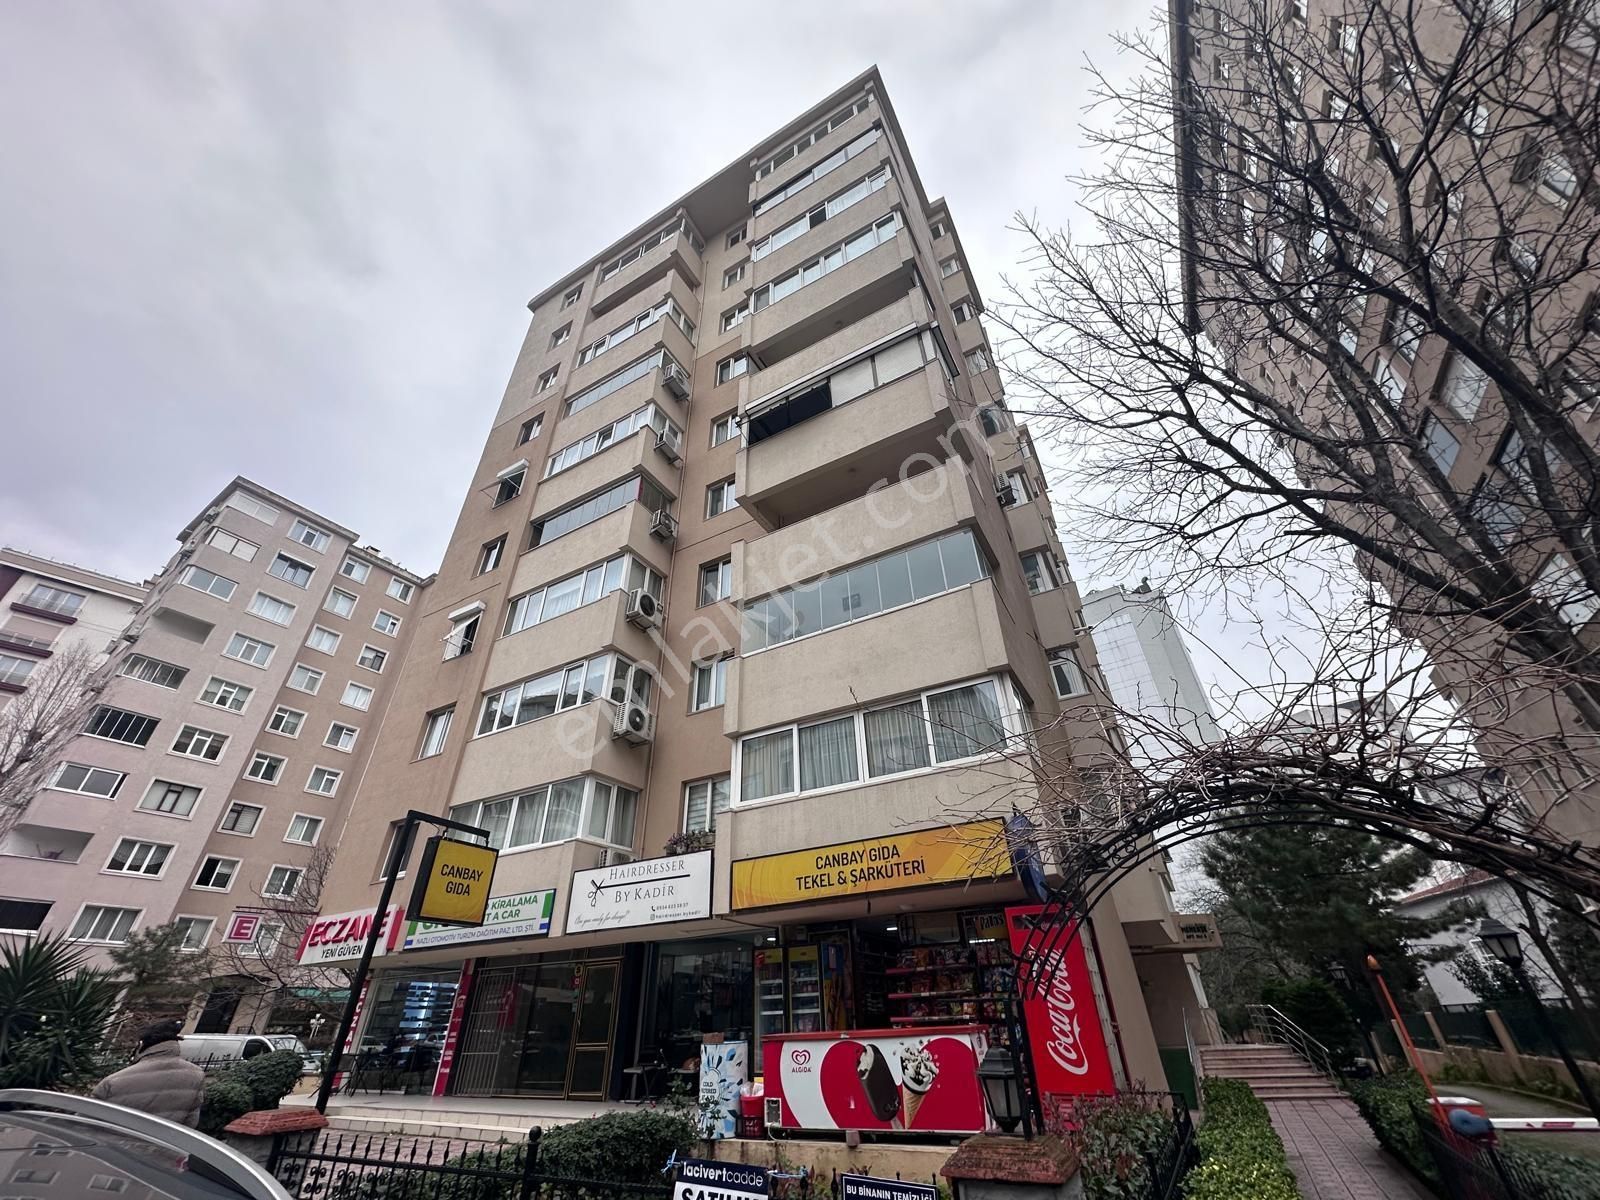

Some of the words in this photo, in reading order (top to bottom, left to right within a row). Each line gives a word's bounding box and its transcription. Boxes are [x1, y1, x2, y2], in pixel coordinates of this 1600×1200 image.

[815, 849, 866, 870] CANBAY
[868, 844, 900, 862] GIDA
[440, 863, 484, 882] CANBAY
[609, 860, 685, 880] HAIRDRESSER
[795, 872, 834, 891] TEKEL
[837, 870, 848, 885] &
[849, 855, 926, 884] ŞARKÜTERİ
[445, 881, 471, 897] GIDA
[615, 890, 630, 903] BY
[491, 894, 538, 911] KİRALAMA
[492, 911, 499, 921] A
[501, 909, 521, 920] CAR
[233, 919, 255, 937] E
[321, 945, 337, 960] YENİ
[336, 943, 362, 957] GÜVEN
[342, 987, 367, 1054] ECZAN
[683, 1161, 764, 1187] lacivertcadde
[846, 1185, 857, 1195] BU
[858, 1185, 891, 1199] BİNANIN
